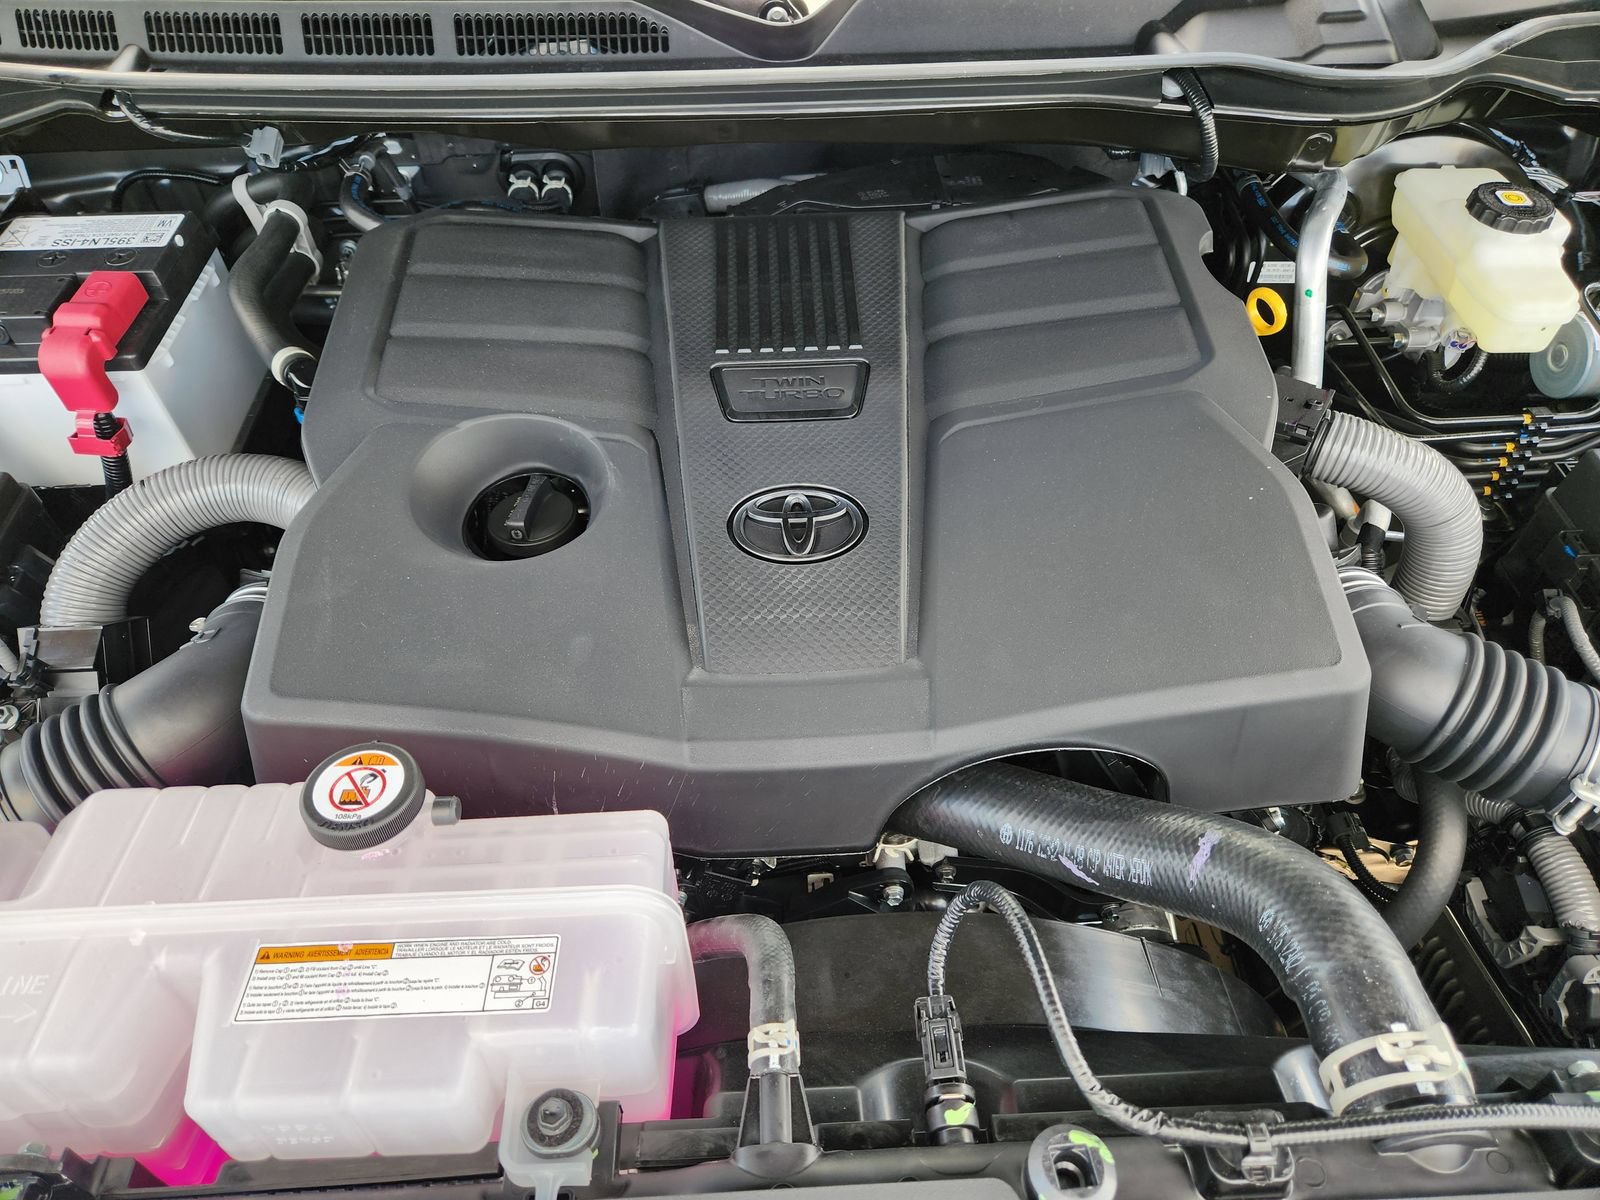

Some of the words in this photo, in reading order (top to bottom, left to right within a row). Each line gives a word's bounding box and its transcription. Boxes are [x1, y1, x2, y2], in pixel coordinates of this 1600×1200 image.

[51, 237, 136, 247] 395LN4-ISS
[752, 375, 825, 387] TWIN
[739, 387, 845, 399] TURBO
[273, 951, 304, 959] WARNING
[0, 975, 49, 995] INE
